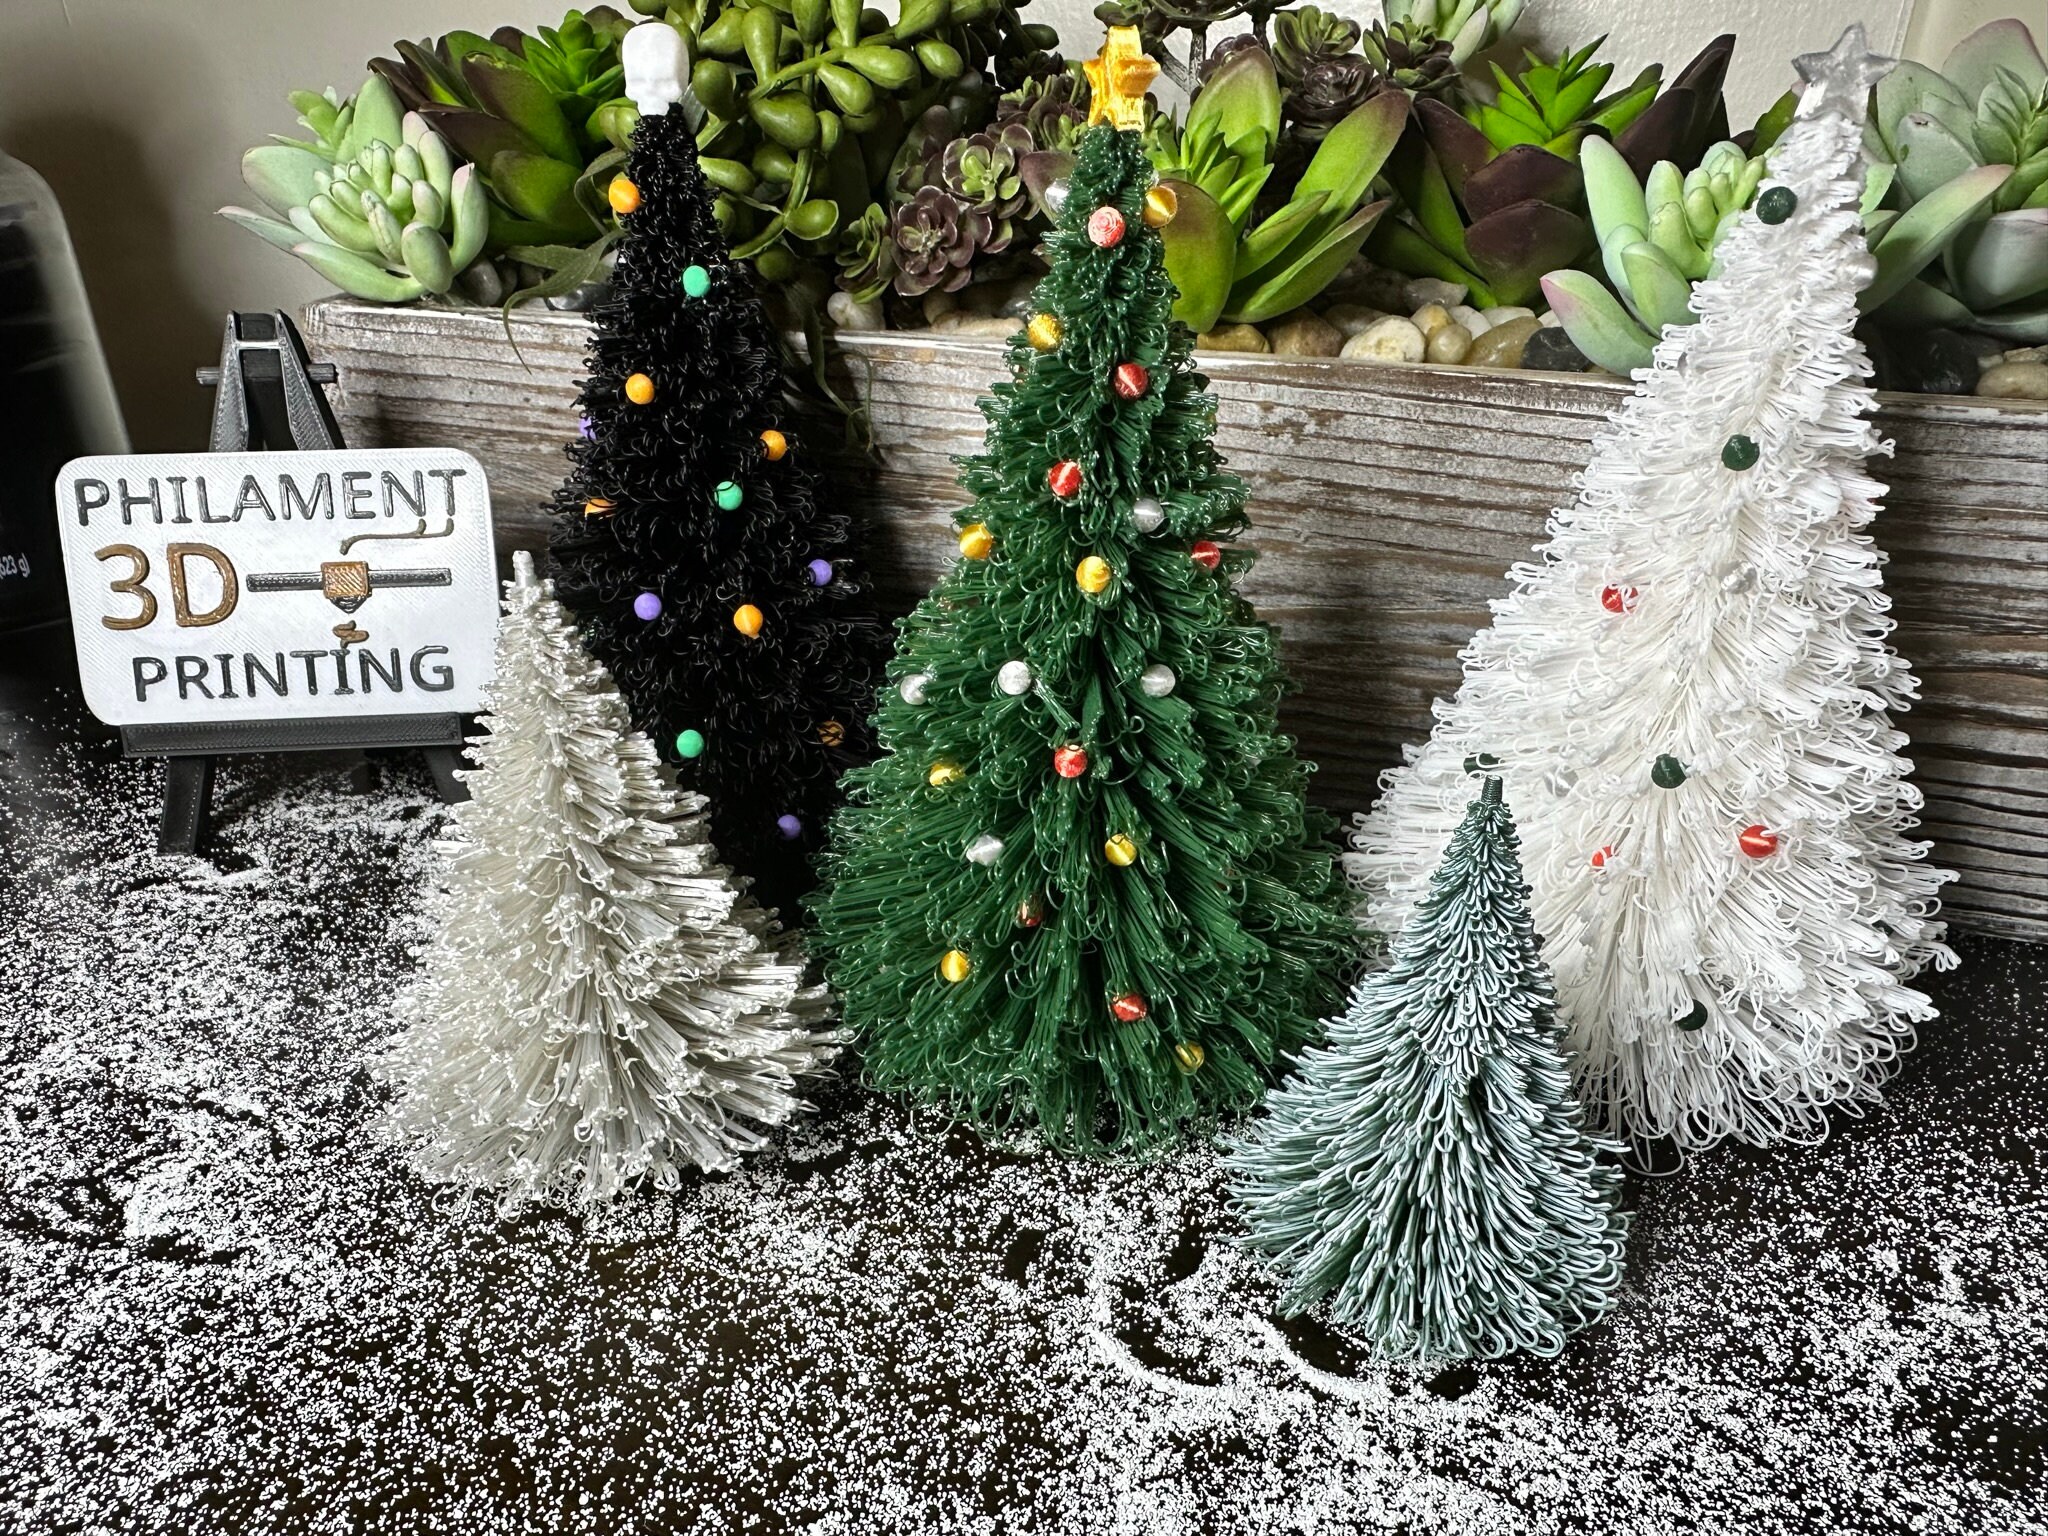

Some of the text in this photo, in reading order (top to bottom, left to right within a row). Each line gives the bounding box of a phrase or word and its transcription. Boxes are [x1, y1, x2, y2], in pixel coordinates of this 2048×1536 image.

[74, 469, 467, 526] PHILAMENT
[94, 541, 239, 631] 3D
[132, 645, 455, 702] PRINTING
